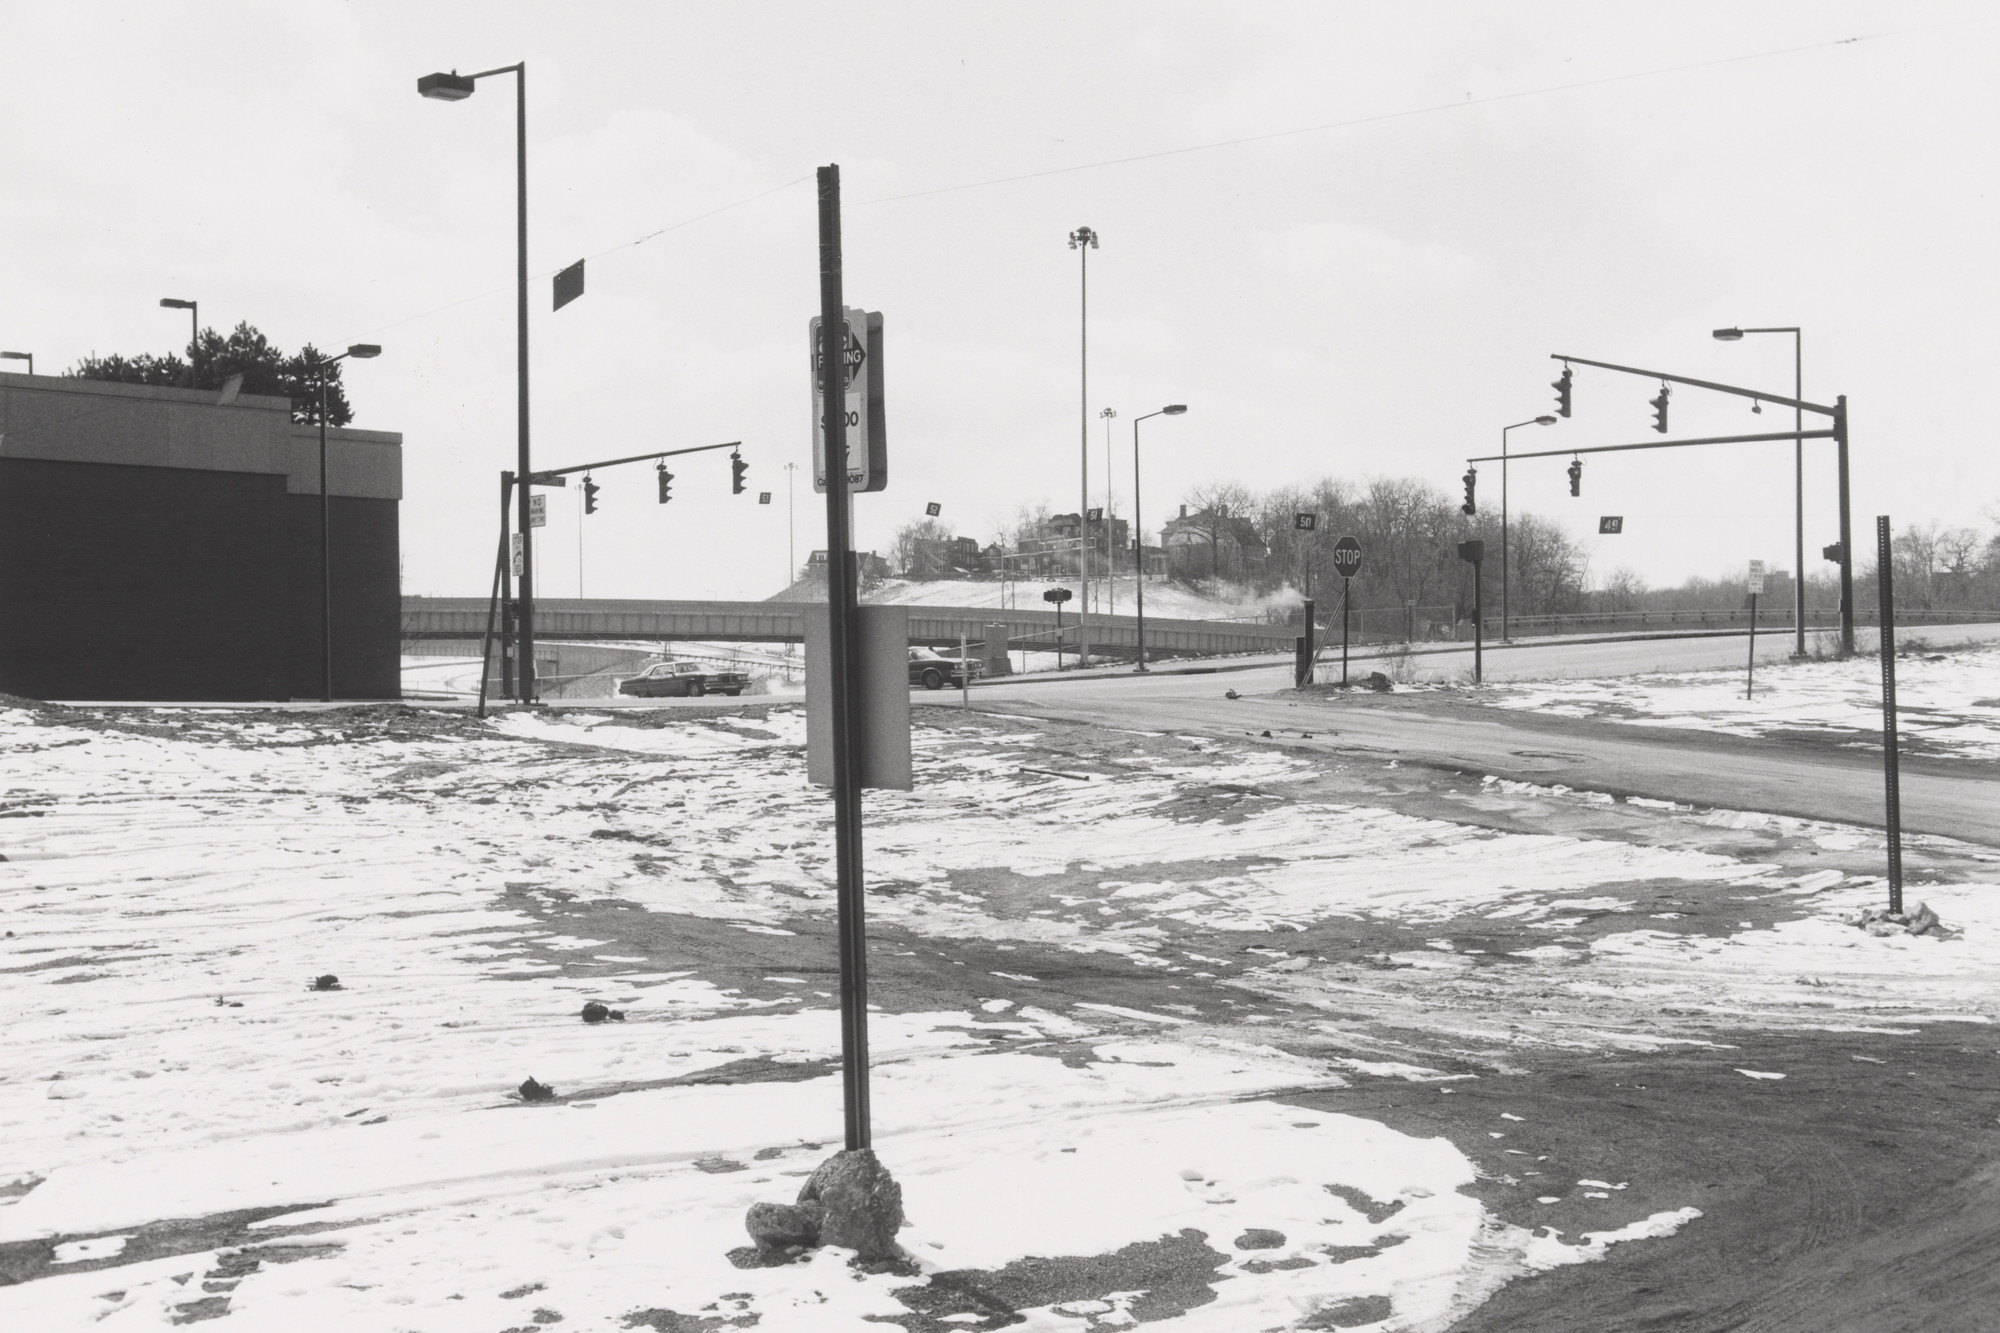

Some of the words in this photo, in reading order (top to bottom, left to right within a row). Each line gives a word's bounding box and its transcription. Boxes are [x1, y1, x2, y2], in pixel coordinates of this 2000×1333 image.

[1300, 516, 1312, 528] 50
[1604, 519, 1619, 531] 49
[1335, 549, 1360, 565] STOP
